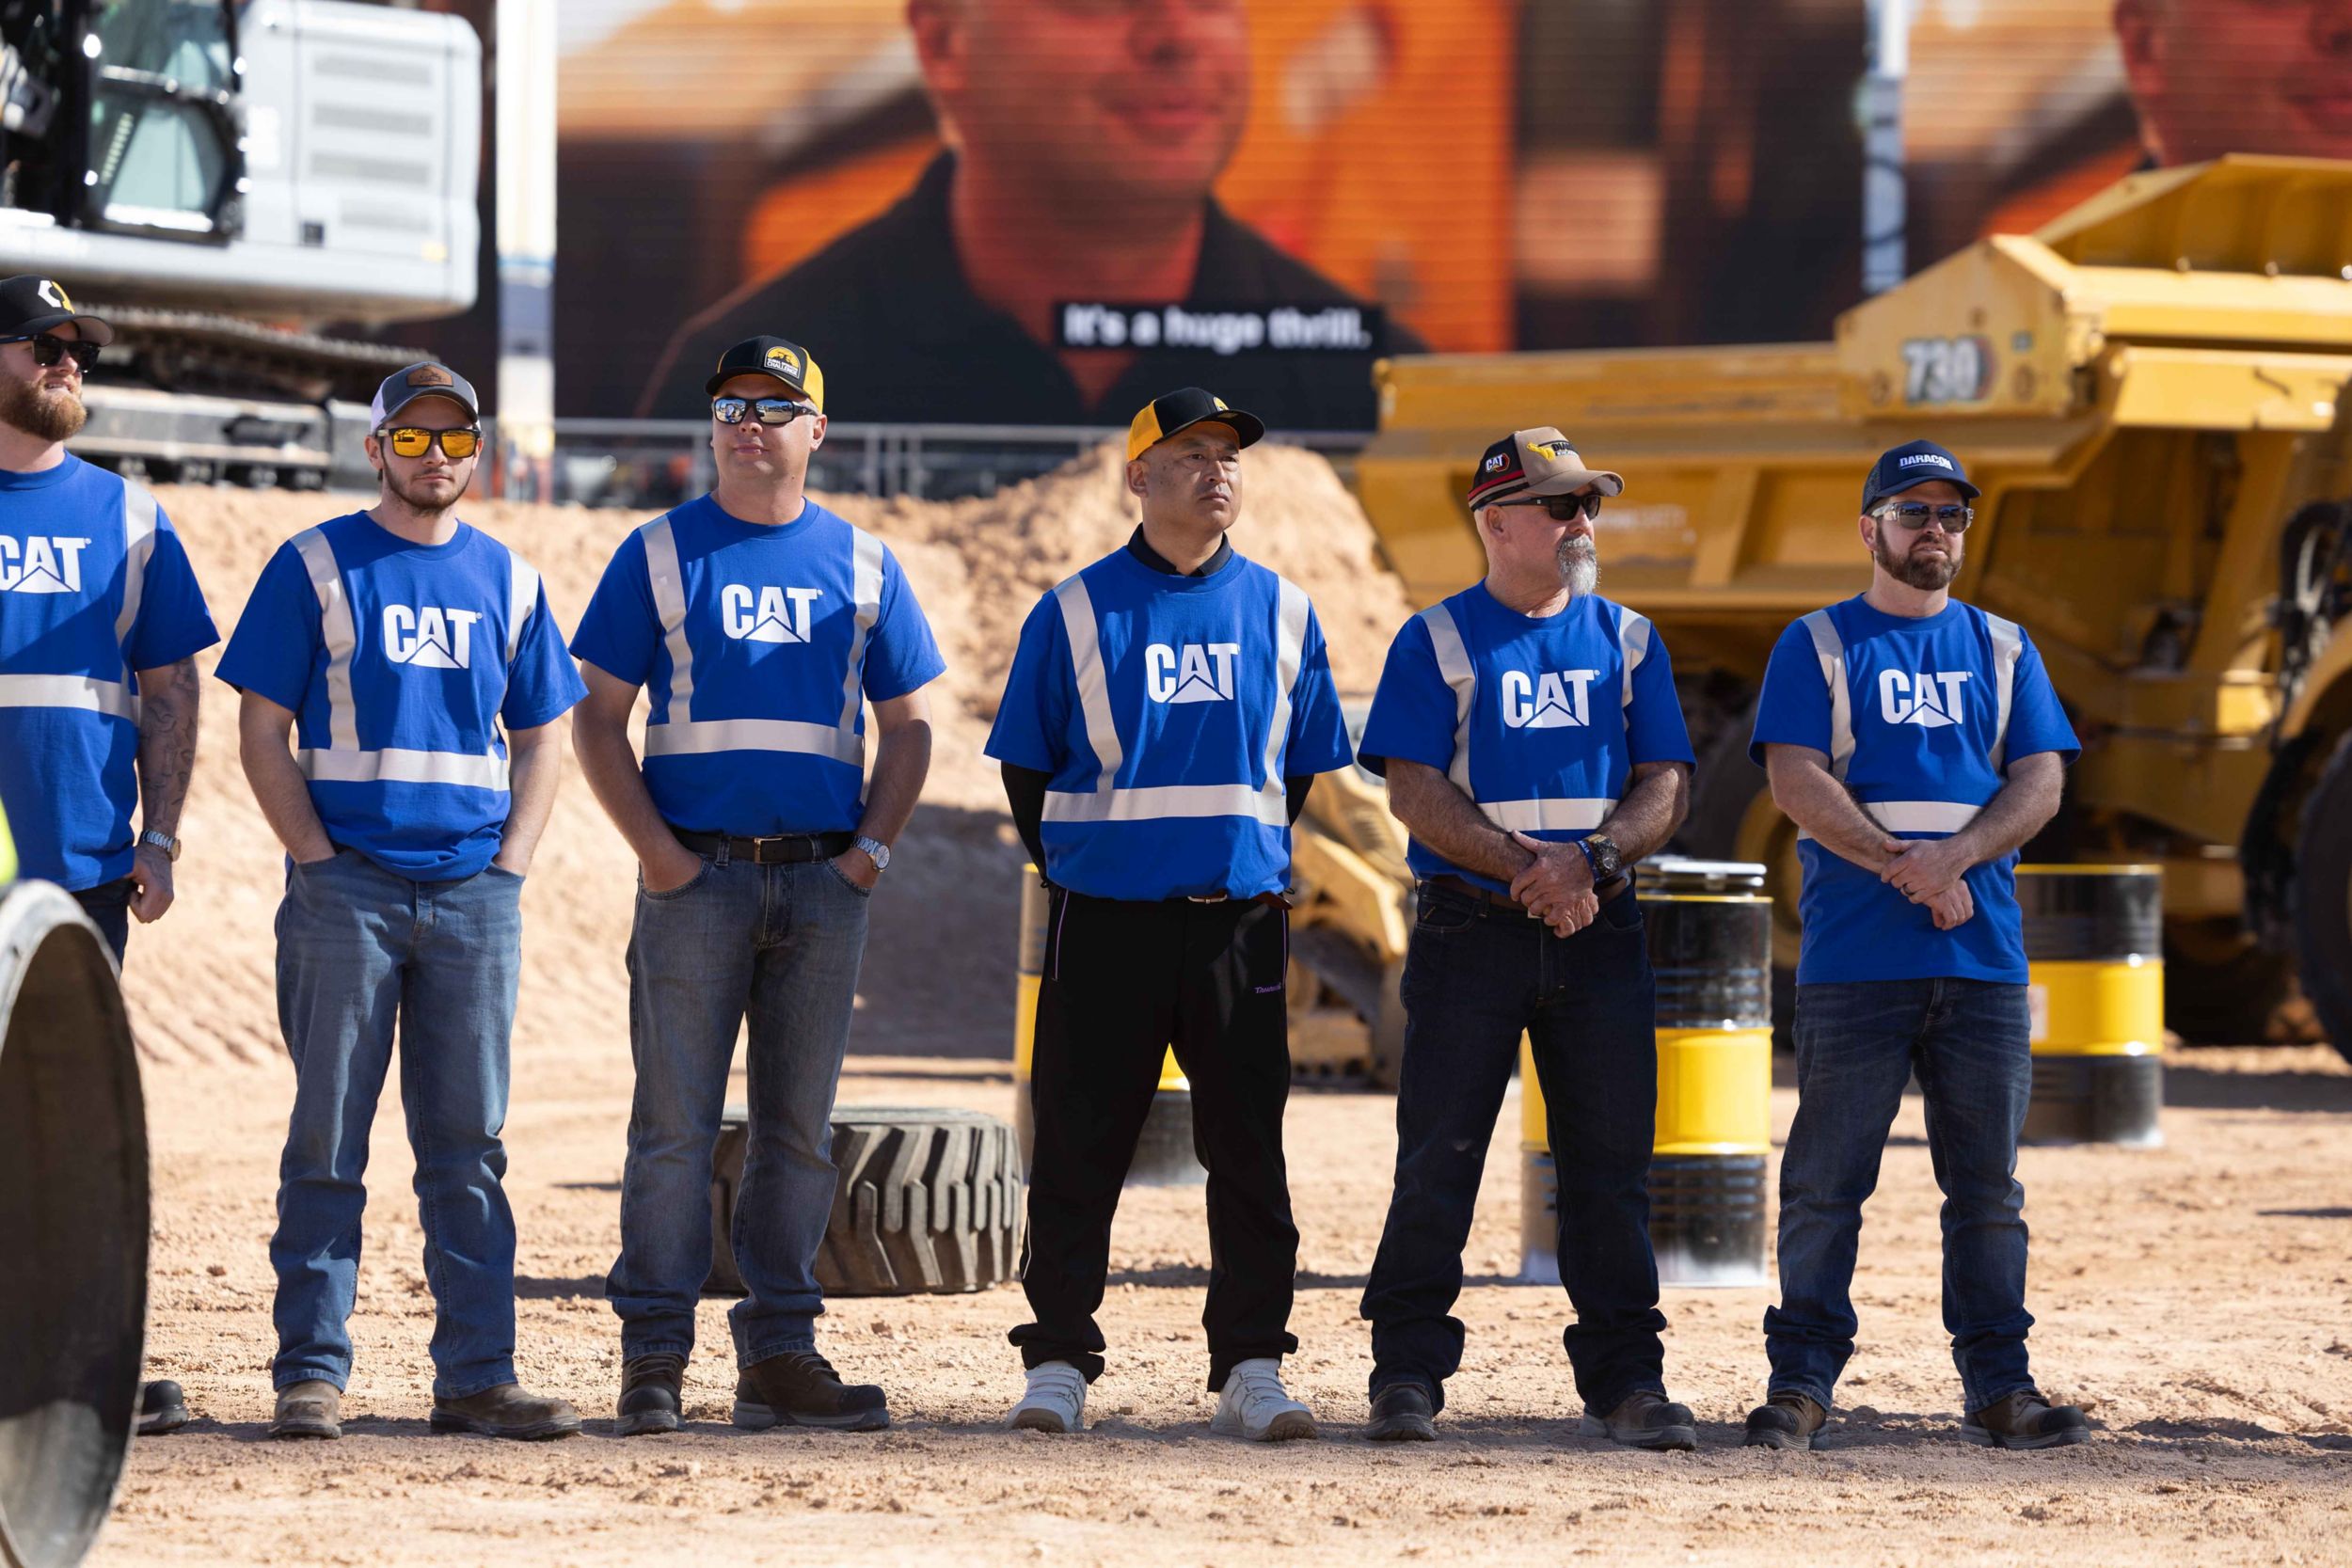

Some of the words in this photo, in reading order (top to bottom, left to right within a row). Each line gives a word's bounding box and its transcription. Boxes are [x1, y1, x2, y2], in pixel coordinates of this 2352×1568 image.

[1064, 304, 1126, 345] It's
[1131, 311, 1161, 345] a
[1164, 306, 1264, 356] huge
[1268, 308, 1373, 349] thrill.
[1901, 337, 1979, 403] 730
[1486, 454, 1503, 471] CAT
[1899, 454, 1954, 470] DARACON
[0, 534, 87, 594] CAT
[383, 604, 477, 669] CAT
[722, 584, 818, 643] CAT
[1145, 642, 1239, 704] CAT
[1502, 669, 1595, 729] CAT
[1879, 669, 1968, 728] CAT
